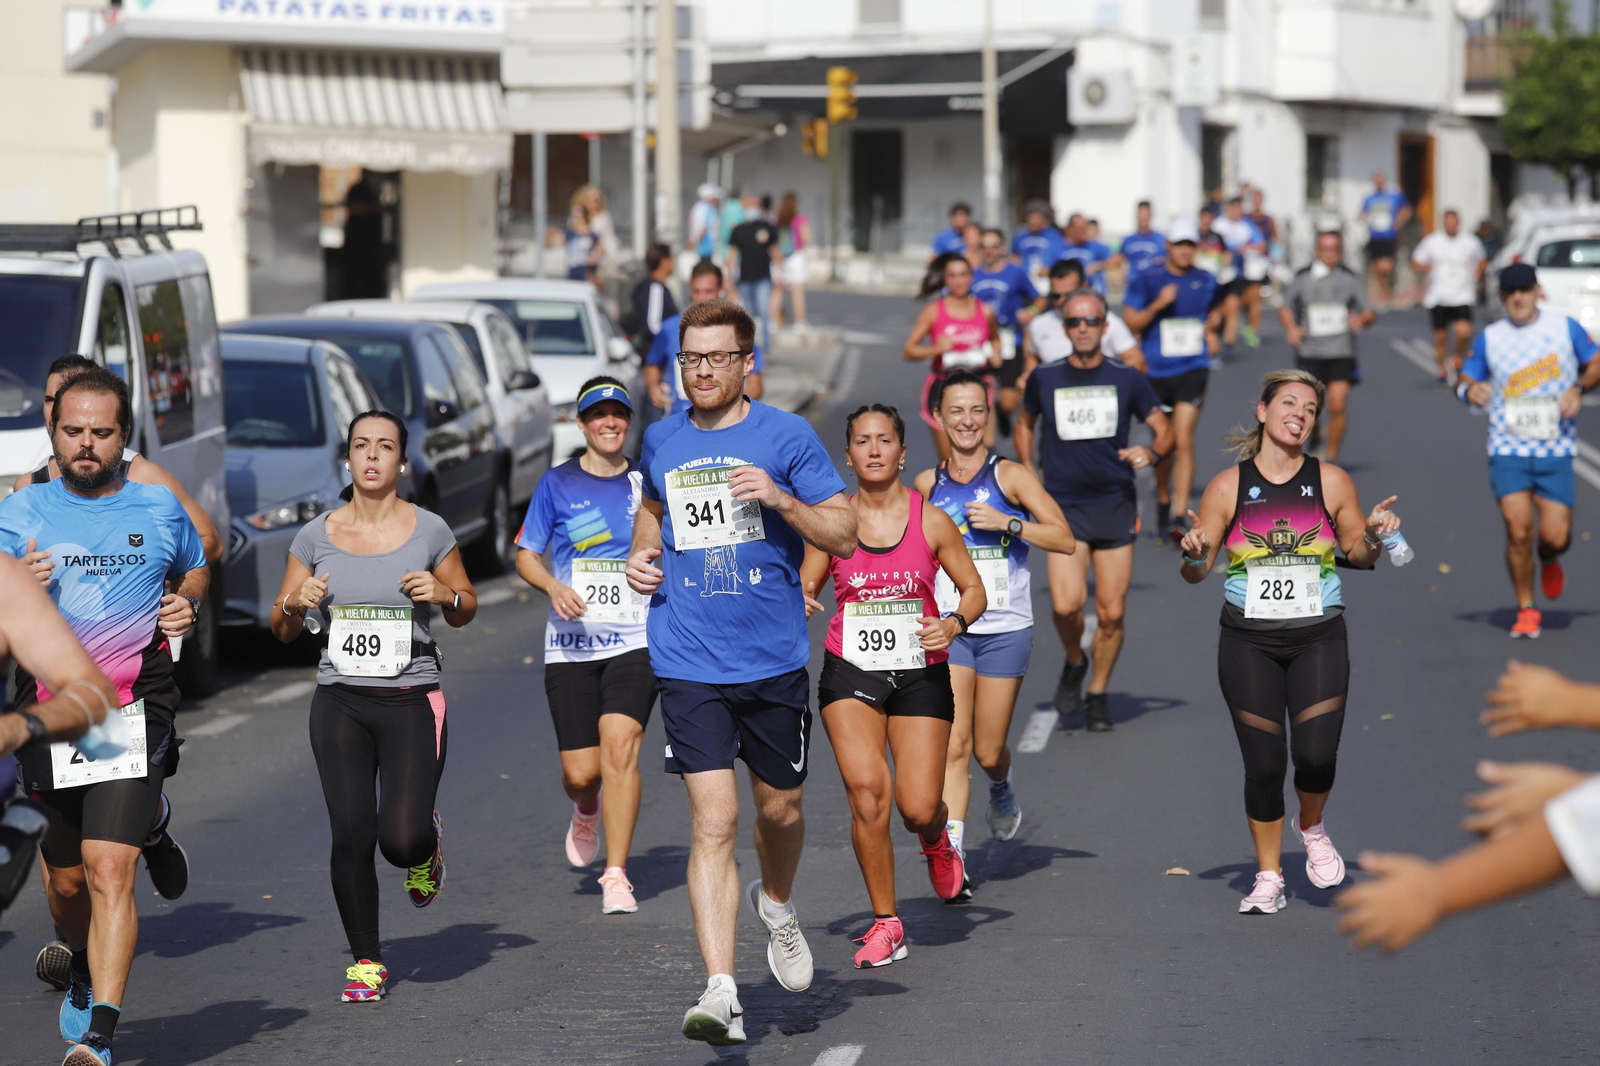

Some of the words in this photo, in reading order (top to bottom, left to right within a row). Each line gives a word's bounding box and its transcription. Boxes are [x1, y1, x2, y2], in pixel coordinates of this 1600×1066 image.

[218, 0, 368, 19] PATATAS
[380, 5, 494, 24] FRITAS
[1068, 409, 1096, 425] 466
[678, 457, 713, 471] VUELTA
[714, 456, 722, 464] A
[672, 476, 681, 487] 34
[683, 473, 711, 486] VUELTA
[712, 472, 718, 482] A
[683, 486, 718, 495] ALEJANDRO
[685, 499, 725, 527] 341
[62, 554, 147, 567] TARTESSOS
[972, 550, 978, 559] A
[978, 549, 1003, 559] HUELVA
[1261, 557, 1284, 566] VUELTA
[1284, 556, 1290, 565] A
[1290, 556, 1316, 565] HUELVA
[85, 568, 122, 576] HUELVA
[587, 562, 611, 571] VUELTA
[612, 562, 618, 571] A
[870, 571, 920, 580] HYROX
[585, 585, 620, 605] 288
[1260, 579, 1295, 600] 282
[336, 609, 344, 618] 34
[345, 609, 369, 619] VUELTA
[370, 609, 376, 619] A
[378, 609, 405, 619] HUELVA
[849, 606, 857, 615] 34
[859, 605, 884, 615] VUELTA
[885, 604, 891, 614] A
[891, 603, 917, 613] HUELVA
[342, 633, 381, 657] 489
[550, 632, 626, 649] HUELVA
[858, 629, 896, 652] 399
